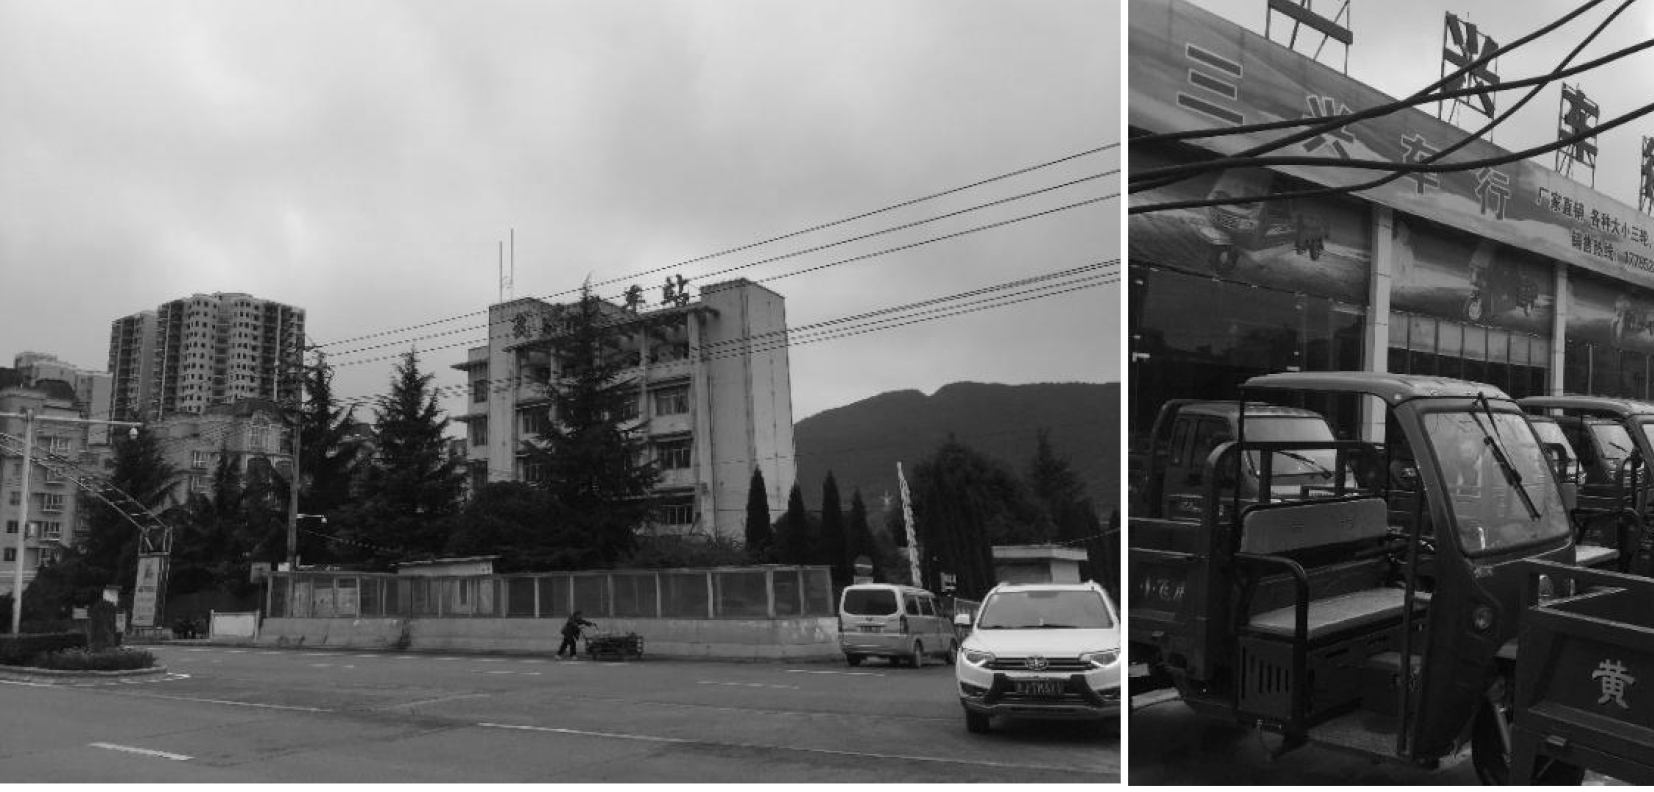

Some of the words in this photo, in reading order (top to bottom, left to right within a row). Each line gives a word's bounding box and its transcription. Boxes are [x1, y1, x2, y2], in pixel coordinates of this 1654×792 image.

[1176, 43, 1512, 221] 三兴车行
[1537, 186, 1585, 222] 厂家直销
